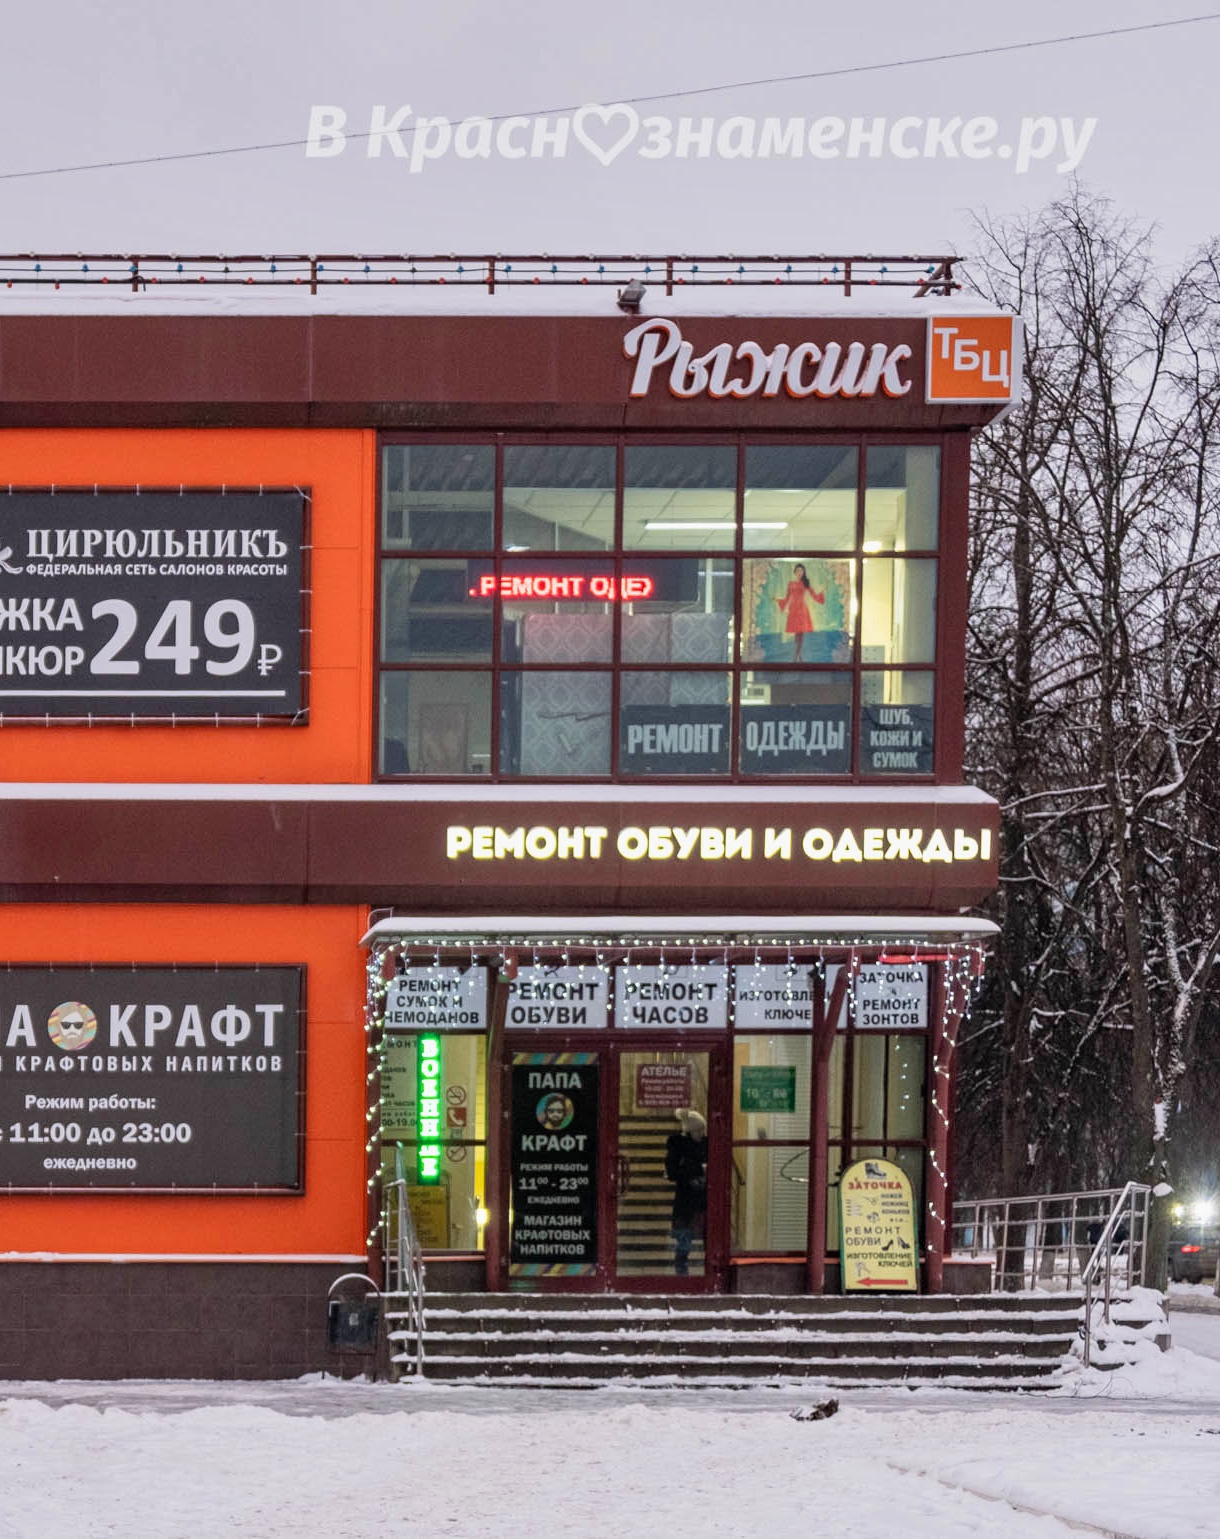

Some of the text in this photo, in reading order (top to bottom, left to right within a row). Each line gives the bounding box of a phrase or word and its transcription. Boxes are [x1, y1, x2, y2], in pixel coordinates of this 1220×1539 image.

[623, 317, 913, 399] Рыжик
[932, 326, 1011, 389] ТБЦ
[26, 529, 288, 559] ЦИРЮЛЬНИКЪ
[26, 563, 287, 577] ФЕДЕРАЛЬНАЯ СЕТЬ САЛОНОВ КРАСОТЫ
[627, 723, 723, 754] РЕМОНТ
[745, 720, 845, 757] ОДЕЖДЫ
[869, 730, 923, 748] КОЖИ И
[872, 751, 918, 769] СУМОК
[445, 826, 992, 863] РЕМОНТ ОБУВИ И ОДЕЖДЫ
[399, 980, 460, 992] РЕМОНТ
[508, 982, 599, 1001] РЕМОНТ
[625, 982, 717, 1001] РЕМОНТ
[396, 996, 447, 1007] СУМОК
[739, 990, 814, 1001] ИЗГОТОВЛ
[863, 999, 920, 1010] РЕМОНТ
[385, 1011, 479, 1025] ЧЕМОДАНОВ
[511, 1006, 587, 1024] ОБУВИ
[633, 1006, 709, 1024] ЧАСОВ
[764, 1008, 812, 1020] КЛЮЧЕ
[863, 1013, 919, 1025] ЗОНТОВ
[109, 1004, 285, 1048] КРАФТ
[16, 1056, 153, 1072] КРАФТОВЫХ
[166, 1055, 283, 1072] НАПИТКОВ
[641, 1066, 687, 1077] АТЕЛЬЕ
[528, 1072, 582, 1089] ПАПА
[24, 1094, 156, 1113] Режим работы:
[9, 1123, 81, 1143] 11:00
[86, 1128, 115, 1146] до
[122, 1123, 192, 1143] 23:00
[521, 1135, 588, 1151] КРАФТ
[43, 1156, 137, 1171] ежедневно
[848, 1182, 902, 1190] ЗАТОЧКА
[524, 1215, 582, 1226] МАГАЗИН
[515, 1230, 591, 1242] КРАФТОВЫХ
[845, 1226, 900, 1235] РЕМОНТ
[520, 1244, 585, 1255] НАПИТКОВ
[845, 1237, 881, 1246] ОБУВИ
